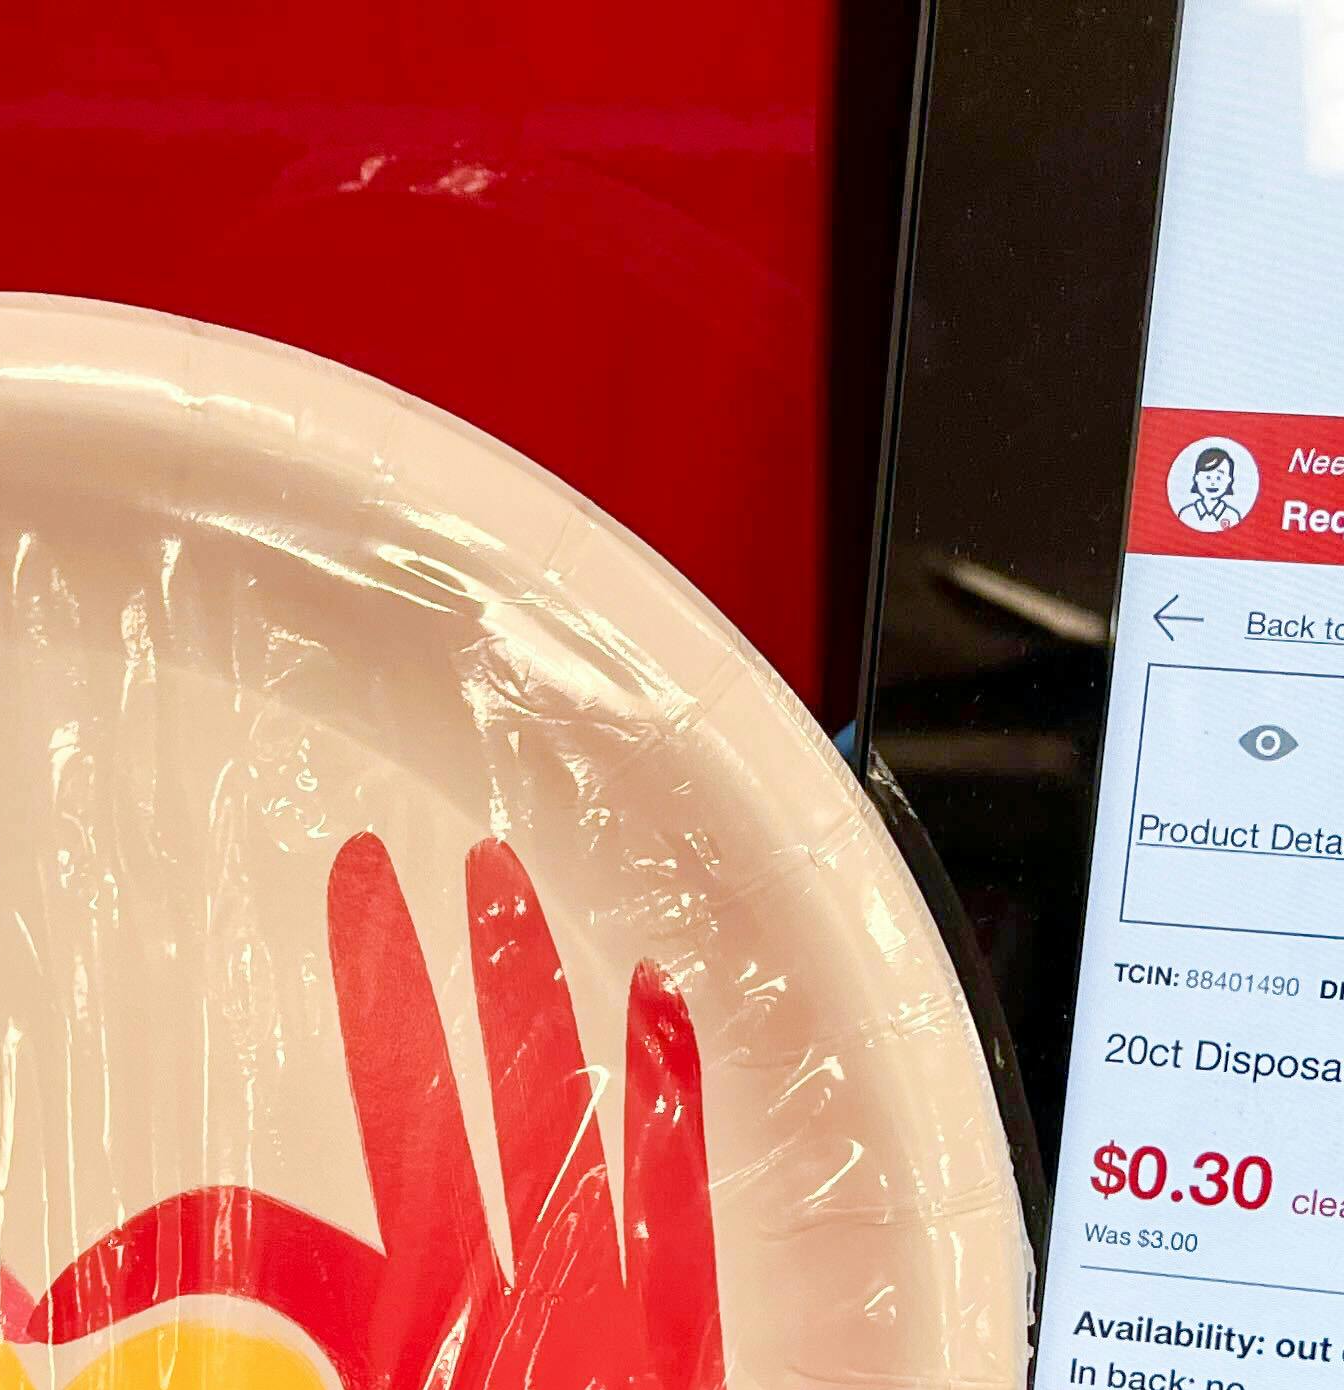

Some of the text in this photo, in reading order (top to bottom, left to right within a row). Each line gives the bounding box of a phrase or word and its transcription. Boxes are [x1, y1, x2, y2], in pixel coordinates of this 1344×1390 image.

[1246, 611, 1316, 640] Back
[1138, 814, 1260, 850] Product
[1114, 964, 1179, 988] TCIN:
[1186, 969, 1300, 999] 88401490
[1105, 1033, 1183, 1069] 20ct
[1089, 1140, 1274, 1211] $0.30
[1084, 1222, 1199, 1252] Was $3.00
[1073, 1310, 1265, 1358] Availability:
[1275, 1334, 1332, 1364] out
[1070, 1359, 1098, 1386] In
